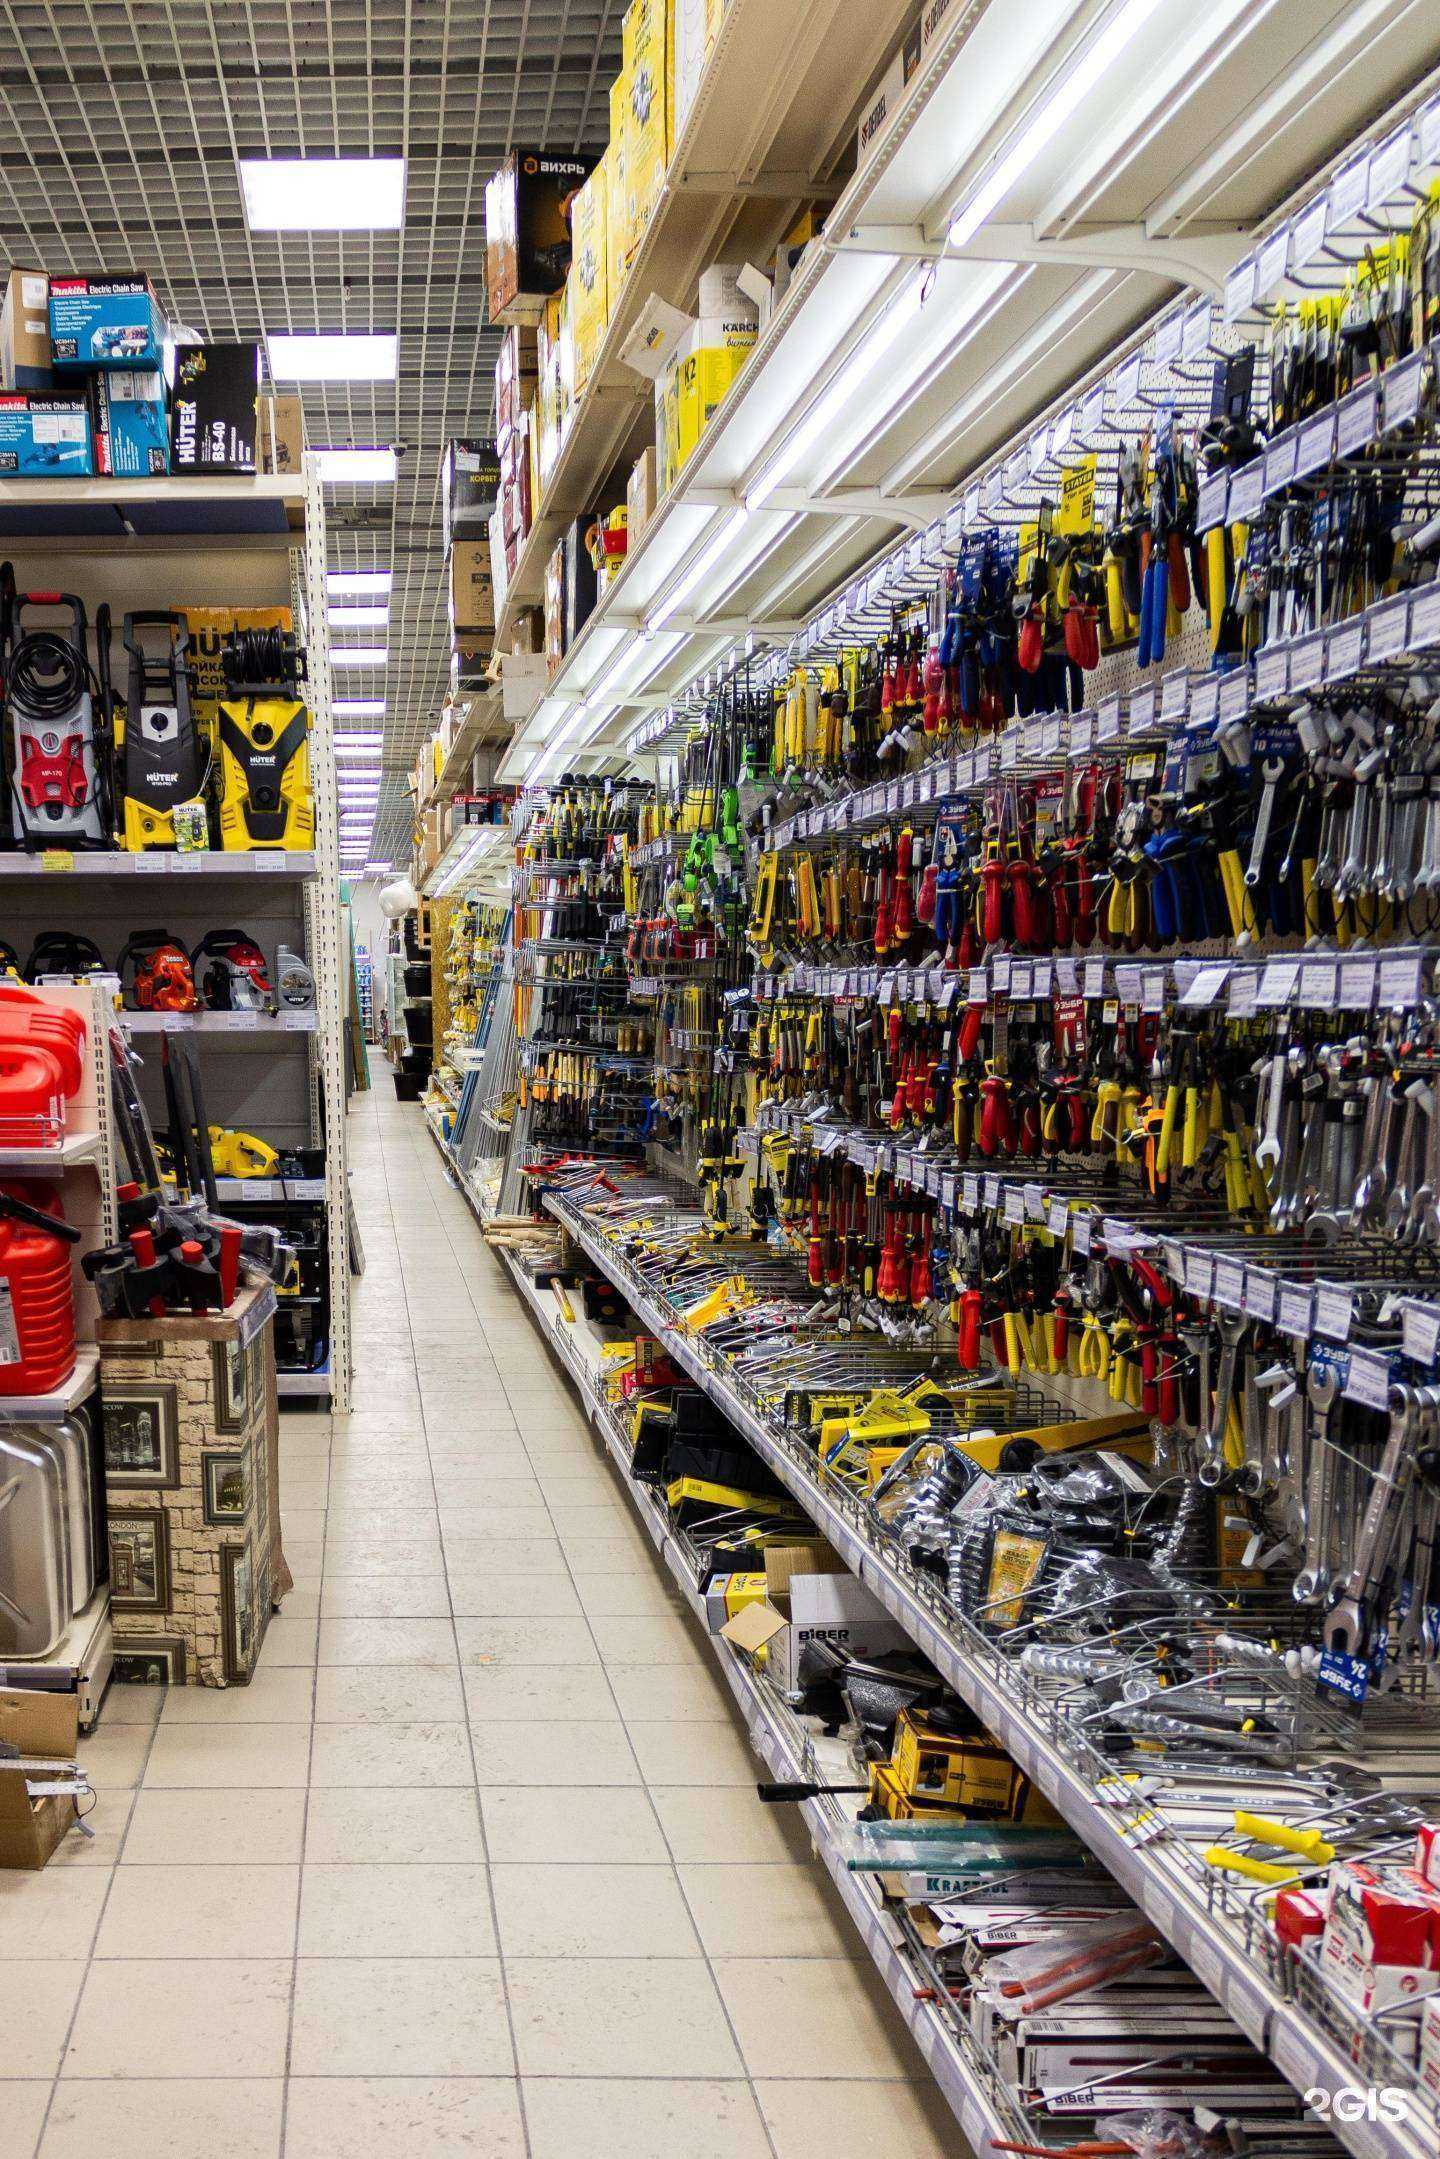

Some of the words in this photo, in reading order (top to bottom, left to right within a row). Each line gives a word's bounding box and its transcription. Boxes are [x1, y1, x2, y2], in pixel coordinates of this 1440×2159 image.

[540, 161, 586, 175] ВИХРЬ
[89, 284, 112, 295] Electric
[112, 283, 130, 293] Chain
[130, 282, 144, 293] Saw
[29, 401, 53, 411] Electric
[53, 401, 71, 411] Chain
[71, 401, 85, 411] Saw
[175, 400, 197, 463] HÜTER
[211, 421, 226, 462] BS-40
[1064, 470, 1094, 494] STAYER
[249, 755, 276, 764] HÜTER
[146, 772, 178, 782] HÜTER
